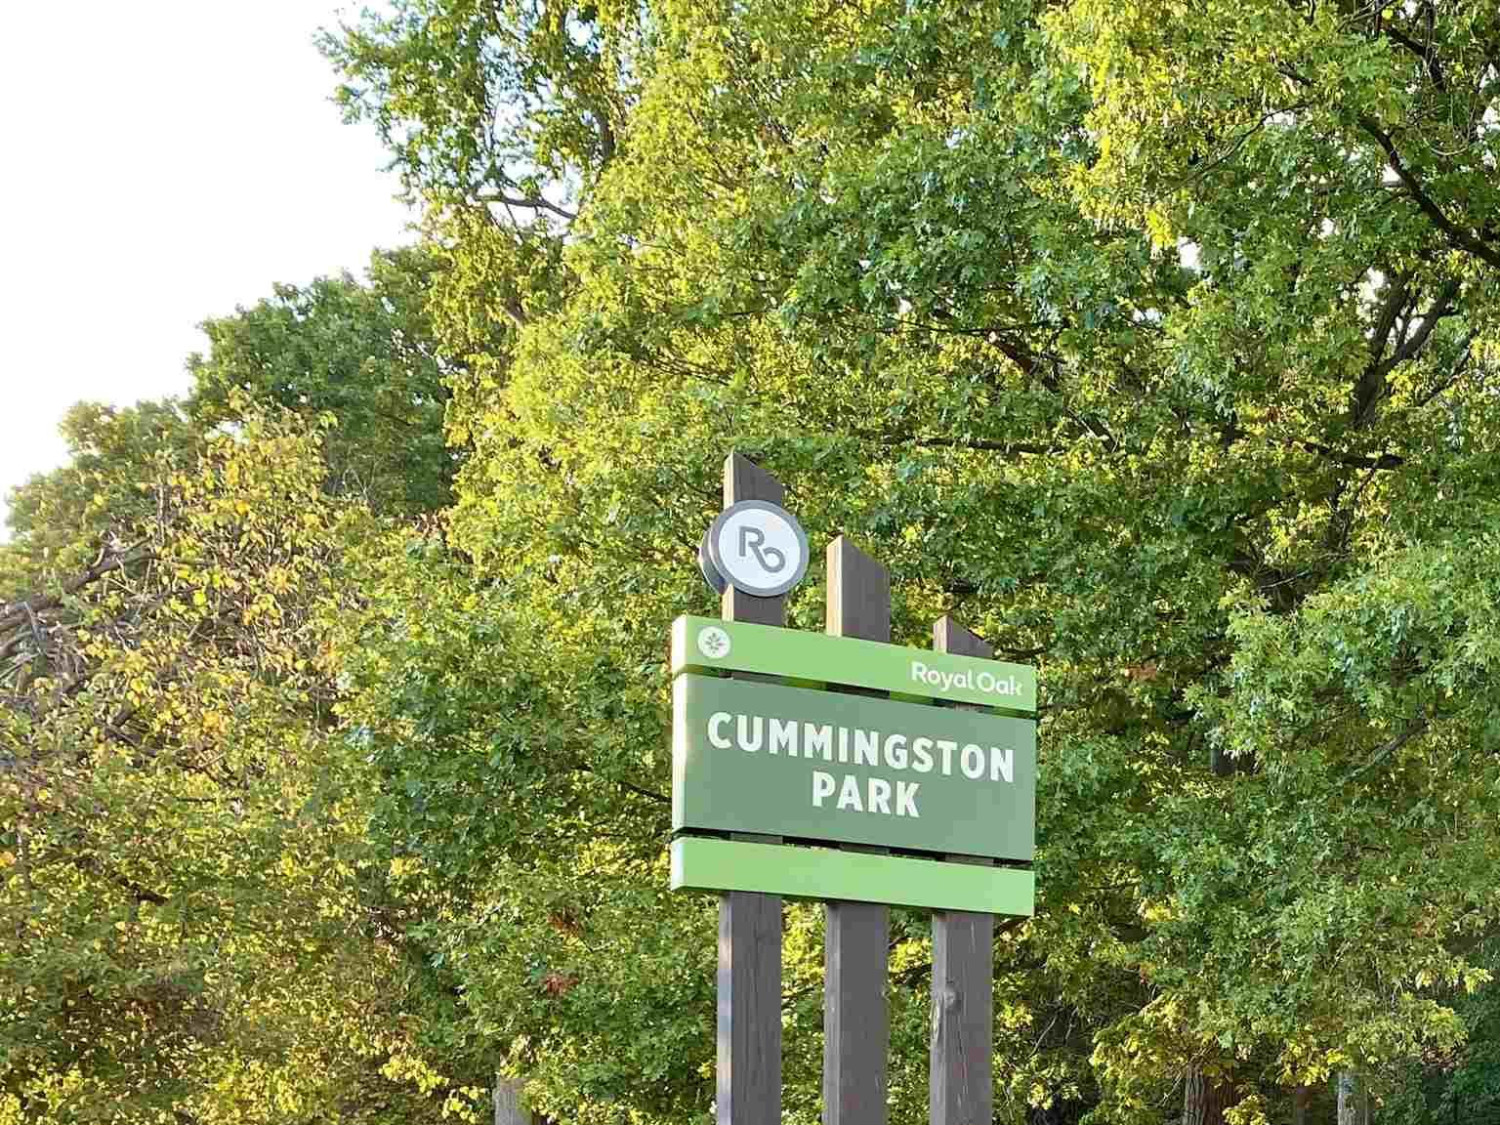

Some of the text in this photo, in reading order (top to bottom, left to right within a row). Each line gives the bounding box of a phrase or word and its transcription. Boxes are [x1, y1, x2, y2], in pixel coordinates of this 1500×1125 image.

[911, 661, 1023, 697] Royal Oak
[707, 711, 1014, 783] CUMMINGSTON
[812, 771, 921, 818] PARK
